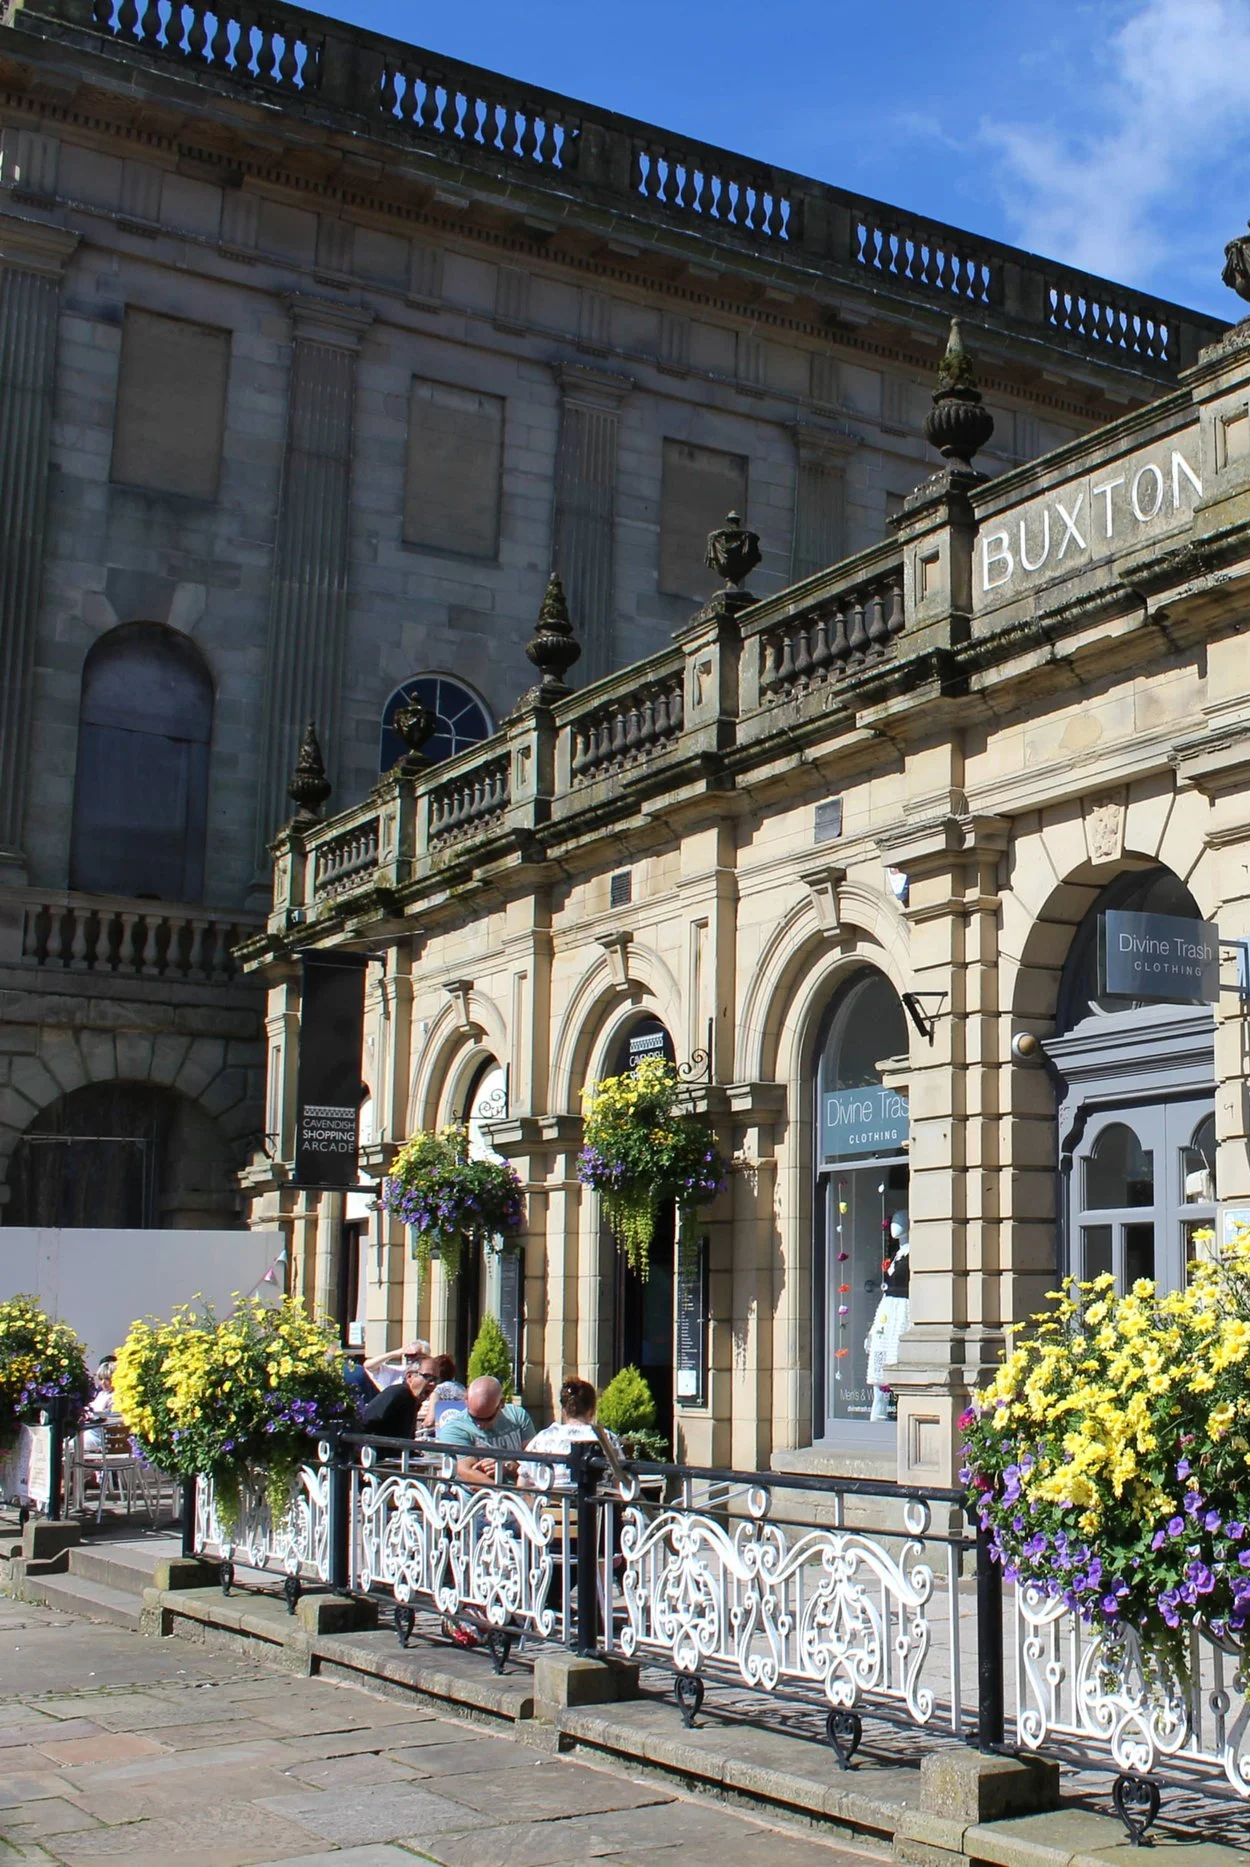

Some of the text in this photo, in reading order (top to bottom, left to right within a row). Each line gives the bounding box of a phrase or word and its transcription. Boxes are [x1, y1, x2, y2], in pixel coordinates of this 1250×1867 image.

[982, 450, 1203, 591] BUXTON
[1118, 933, 1212, 961] Divine Trash
[1134, 960, 1202, 977] CLOTHING
[827, 1091, 909, 1127] Divine Tras
[302, 1118, 356, 1130] CAVENDISH
[302, 1129, 355, 1141] SHOPPING
[849, 1129, 898, 1145] CLOTHING
[302, 1141, 355, 1153] ARCADE
